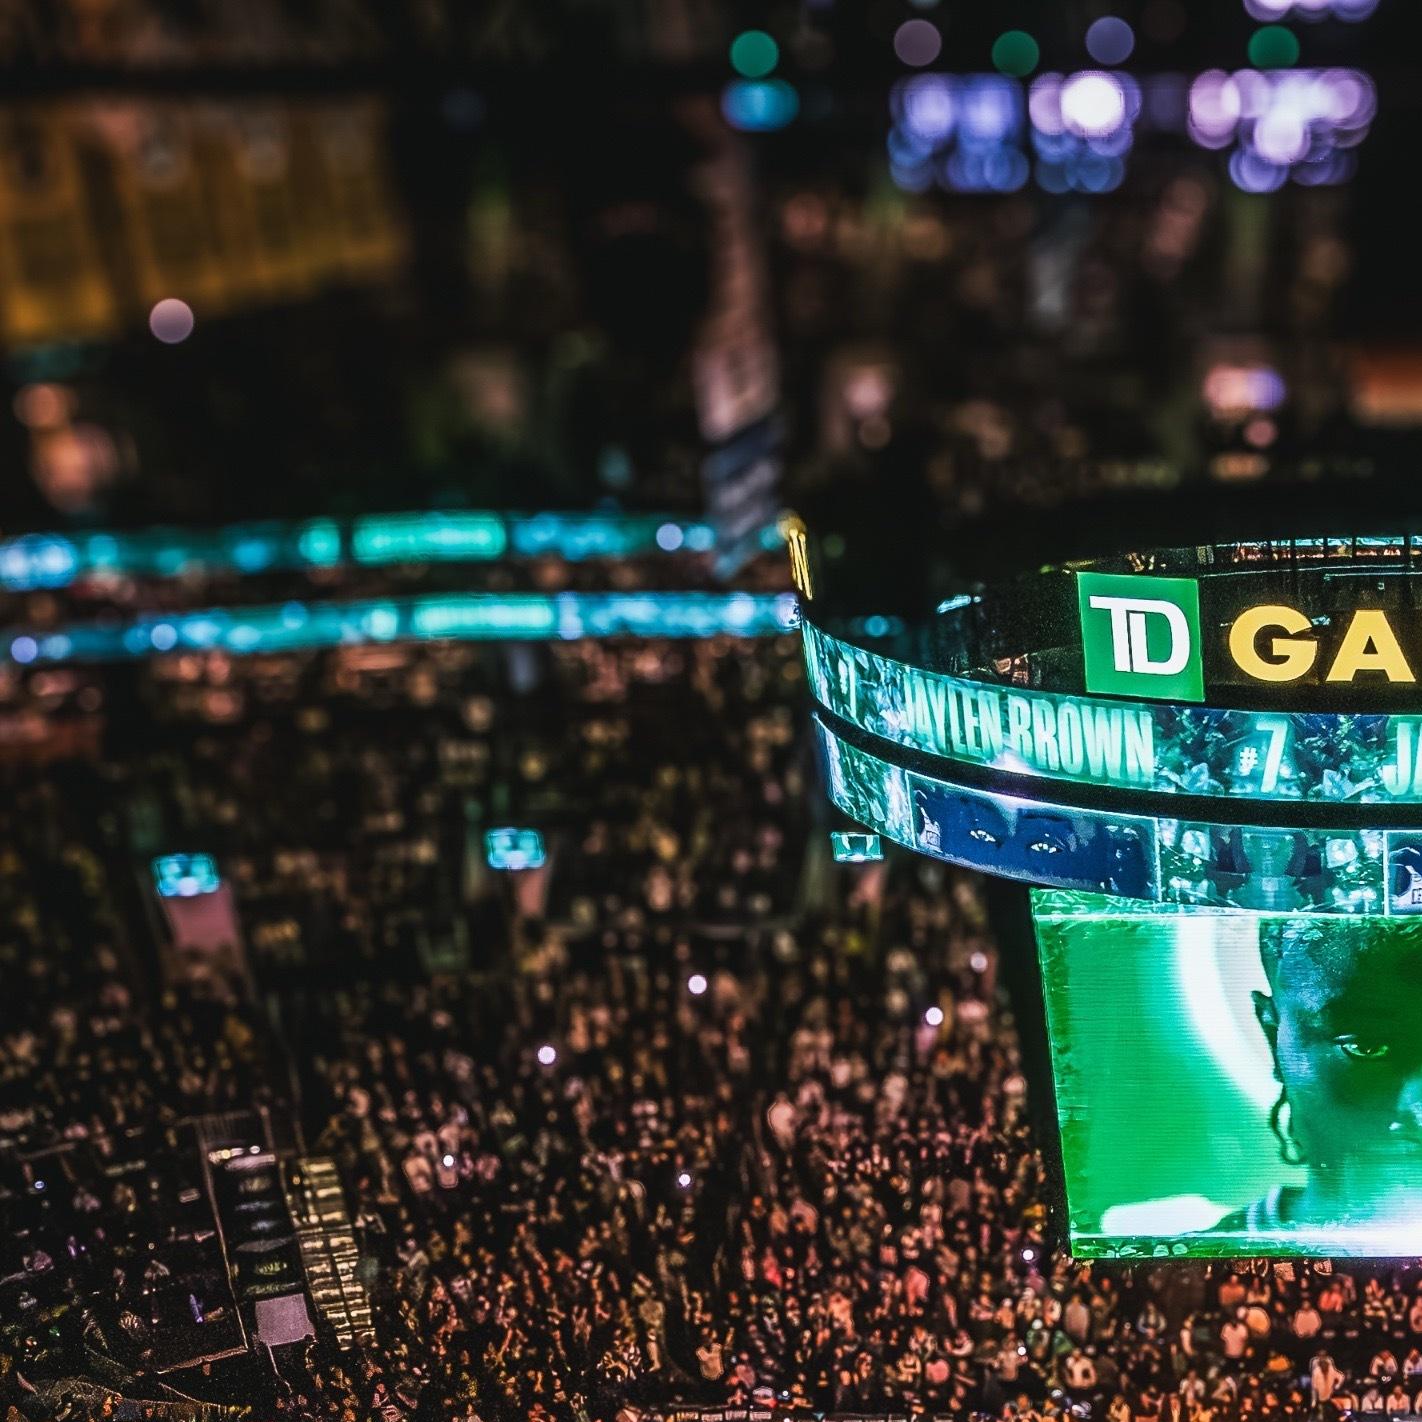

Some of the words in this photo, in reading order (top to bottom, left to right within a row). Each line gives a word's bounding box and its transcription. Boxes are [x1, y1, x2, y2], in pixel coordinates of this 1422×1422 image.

[1089, 595, 1190, 676] TD
[903, 673, 1003, 757] JAYLEN
[1006, 696, 1153, 781] BROWN
[1239, 721, 1288, 793] #7
